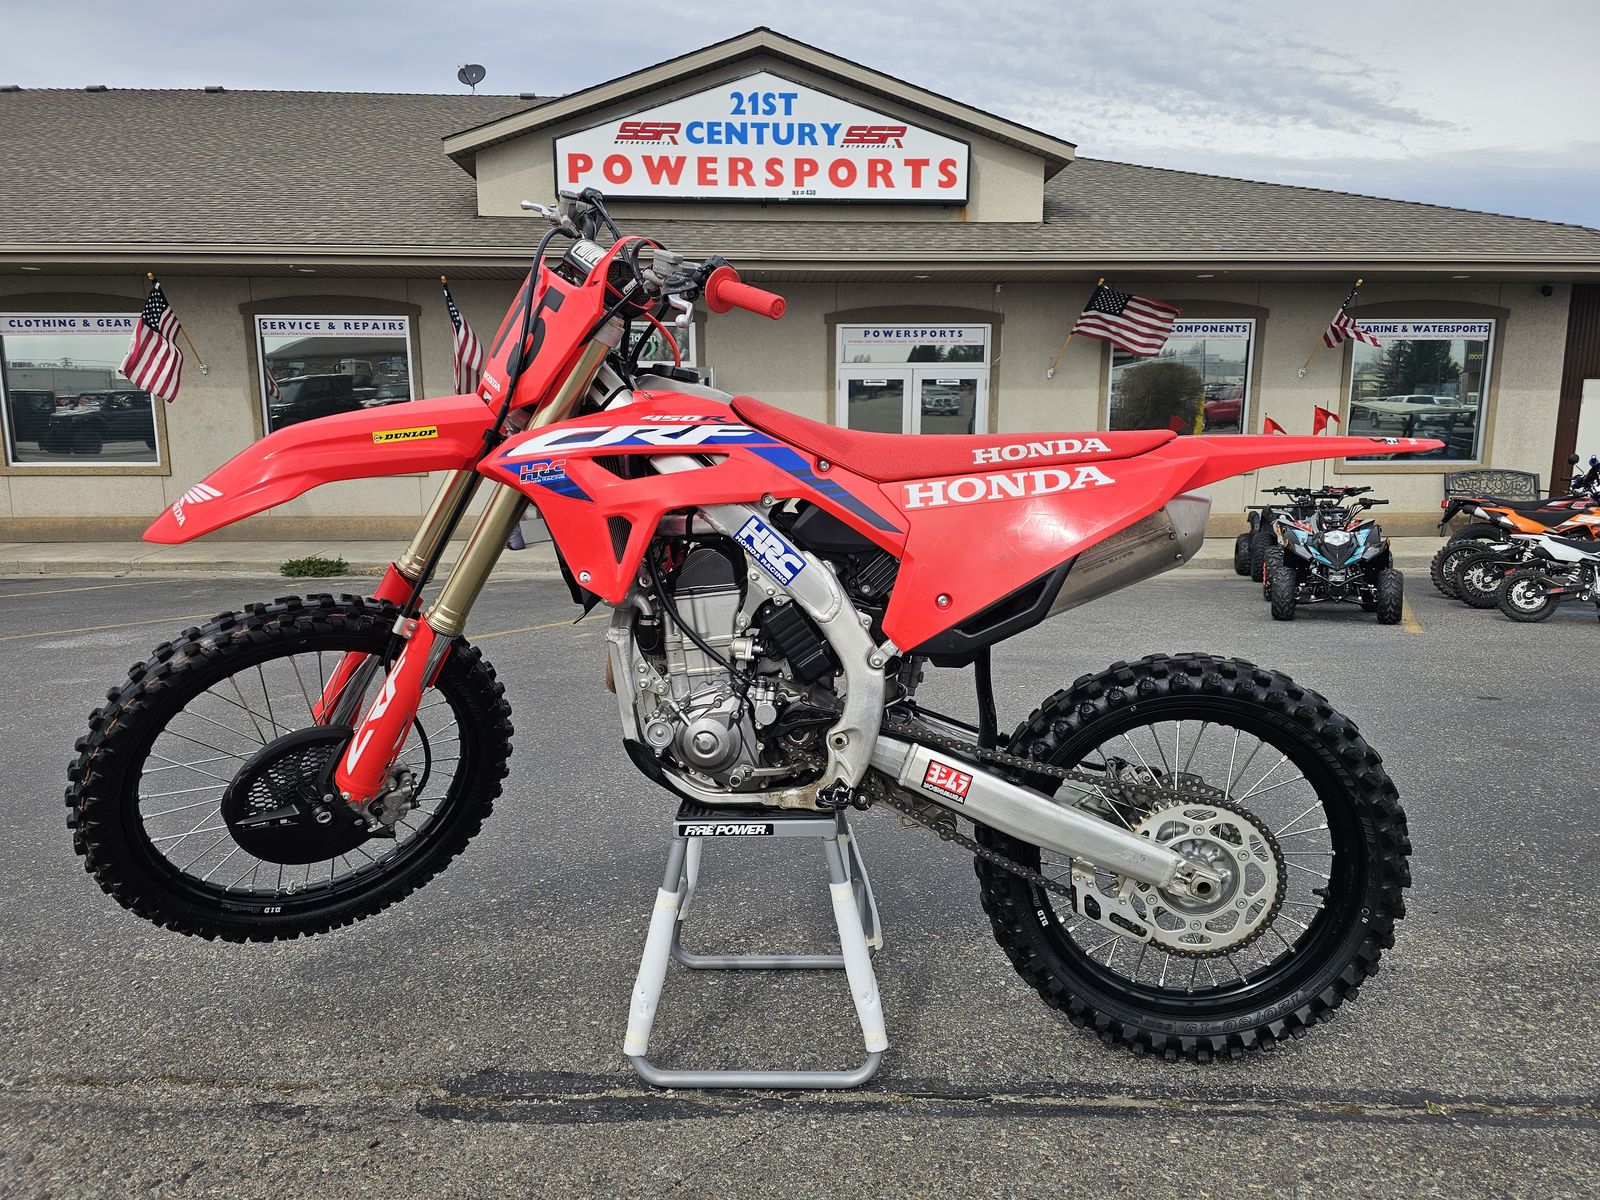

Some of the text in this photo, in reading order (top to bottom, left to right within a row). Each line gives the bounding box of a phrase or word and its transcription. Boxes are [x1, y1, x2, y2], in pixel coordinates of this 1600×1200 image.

[729, 92, 798, 116] 21ST
[616, 122, 682, 145] SSR
[685, 121, 842, 146] CENTURY
[842, 126, 907, 148] SSR
[567, 153, 958, 189] POWERSPORTS
[8, 319, 132, 328] CLOTHING & GEAR
[262, 322, 404, 330] SERVICE & REPAIRS
[864, 330, 963, 338] POWERSPORTS
[1401, 325, 1408, 333] &
[1413, 325, 1489, 333] WATERSPORTS
[384, 429, 437, 441] DUNLOP
[506, 424, 756, 457] CRF
[972, 438, 1111, 464] HONDA
[520, 459, 566, 481] HRC
[904, 466, 1115, 508] HONDA
[735, 534, 788, 585] HONDA RACING
[739, 517, 804, 581] HRC
